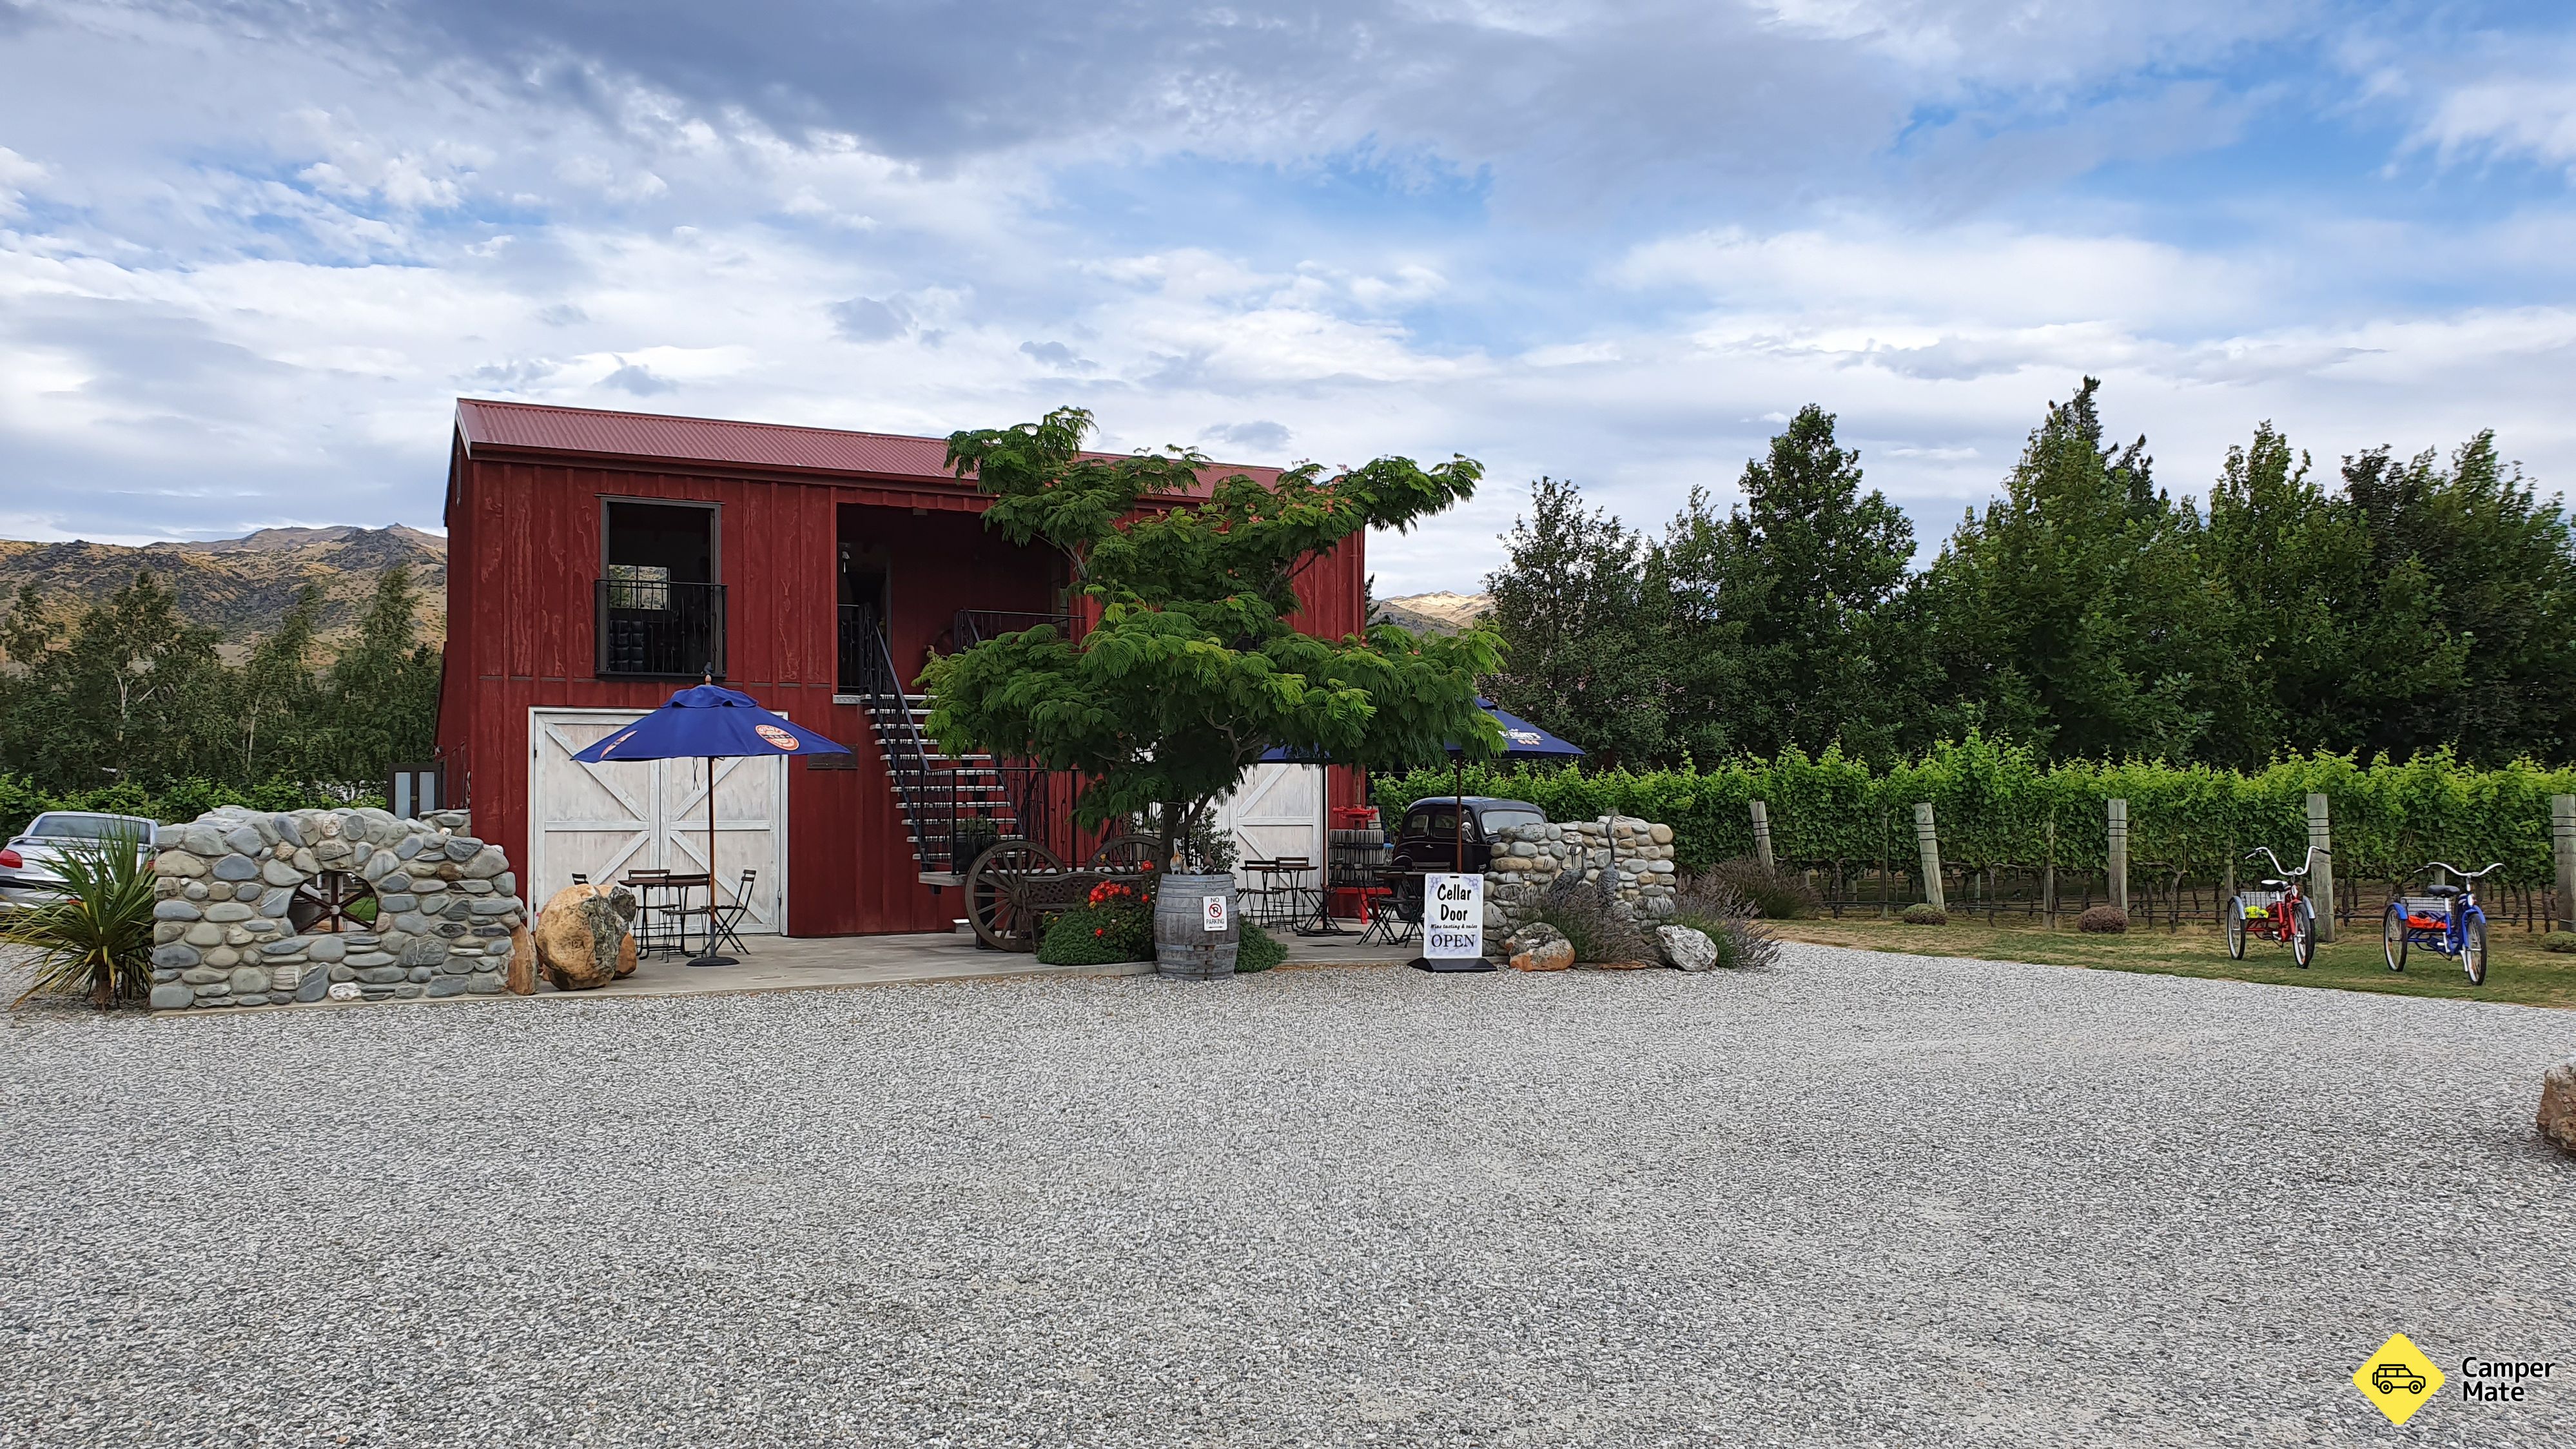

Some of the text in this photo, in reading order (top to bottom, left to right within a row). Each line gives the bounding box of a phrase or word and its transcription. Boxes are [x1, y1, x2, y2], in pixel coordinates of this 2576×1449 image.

[1437, 884, 1471, 900] Cellar
[1441, 904, 1468, 921] Door
[1431, 934, 1475, 948] OPEN
